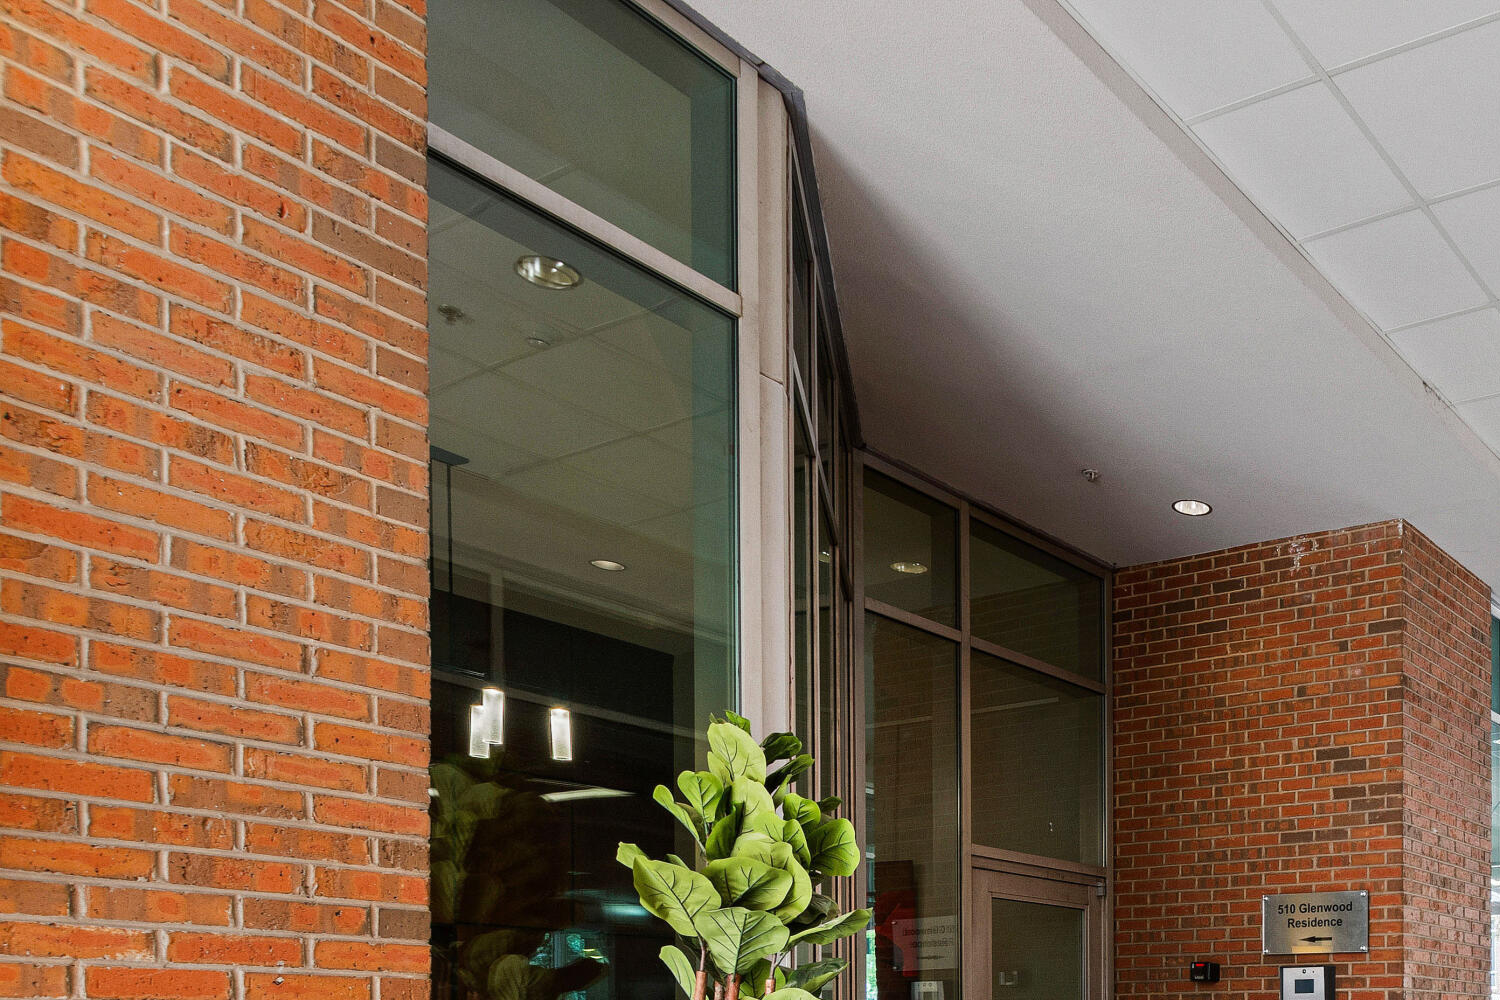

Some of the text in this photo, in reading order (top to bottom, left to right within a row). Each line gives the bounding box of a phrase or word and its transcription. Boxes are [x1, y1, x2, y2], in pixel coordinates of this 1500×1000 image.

[1278, 901, 1353, 914] 510 Glenwood
[1287, 917, 1343, 928] Residence
